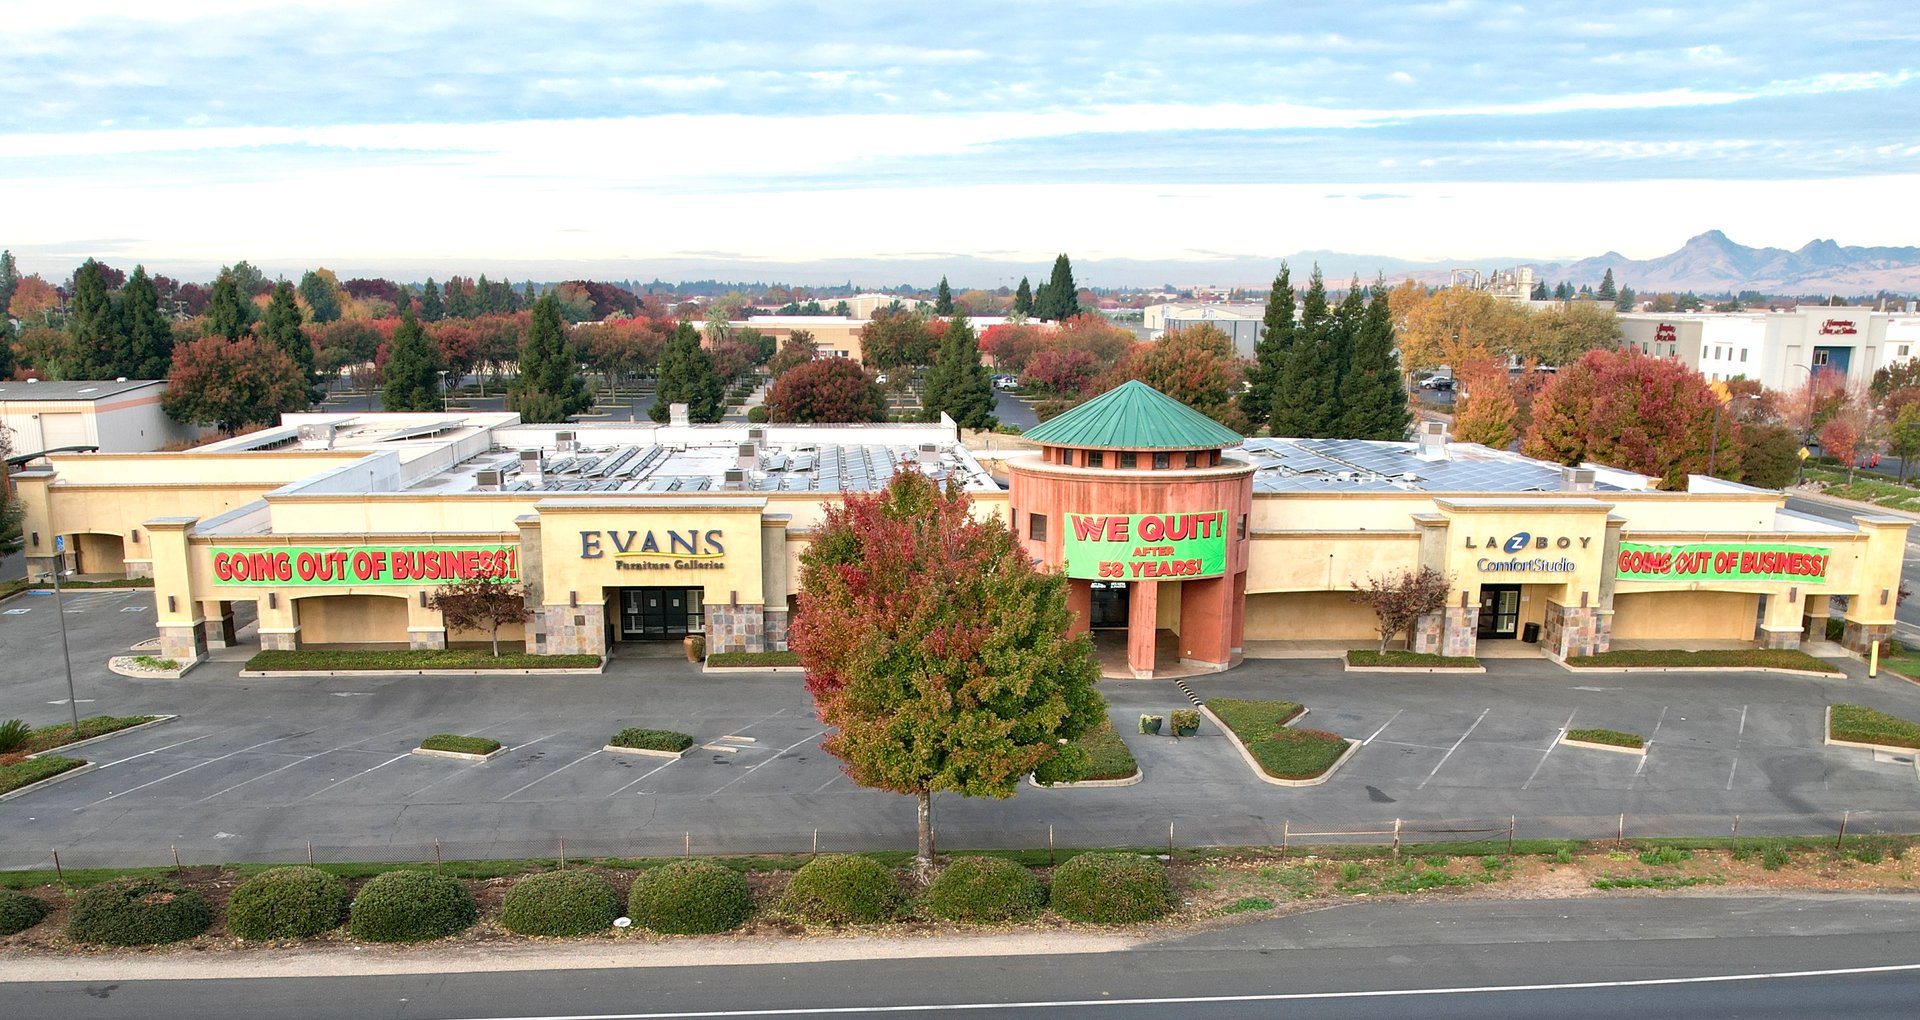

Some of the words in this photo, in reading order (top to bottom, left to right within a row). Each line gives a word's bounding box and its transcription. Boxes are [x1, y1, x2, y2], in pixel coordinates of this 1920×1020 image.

[1071, 515, 1130, 542] WE
[1138, 512, 1223, 542] QUIT!
[580, 530, 725, 559] EVANS
[1132, 546, 1175, 557] AFTER
[214, 552, 293, 581] GOING
[297, 552, 348, 580] OUT
[353, 551, 388, 580] OF
[391, 550, 517, 579] BUSINESS!
[616, 560, 670, 570] Furniture
[674, 560, 725, 570] Galleries
[1098, 561, 1125, 578] 58
[1129, 559, 1203, 577] YEARS!
[1477, 557, 1577, 572] ComfortStudio
[1618, 550, 1672, 575] GOING
[1676, 551, 1712, 574] OUT
[1714, 551, 1738, 574] OF
[1740, 551, 1829, 577] BUSINESS!
